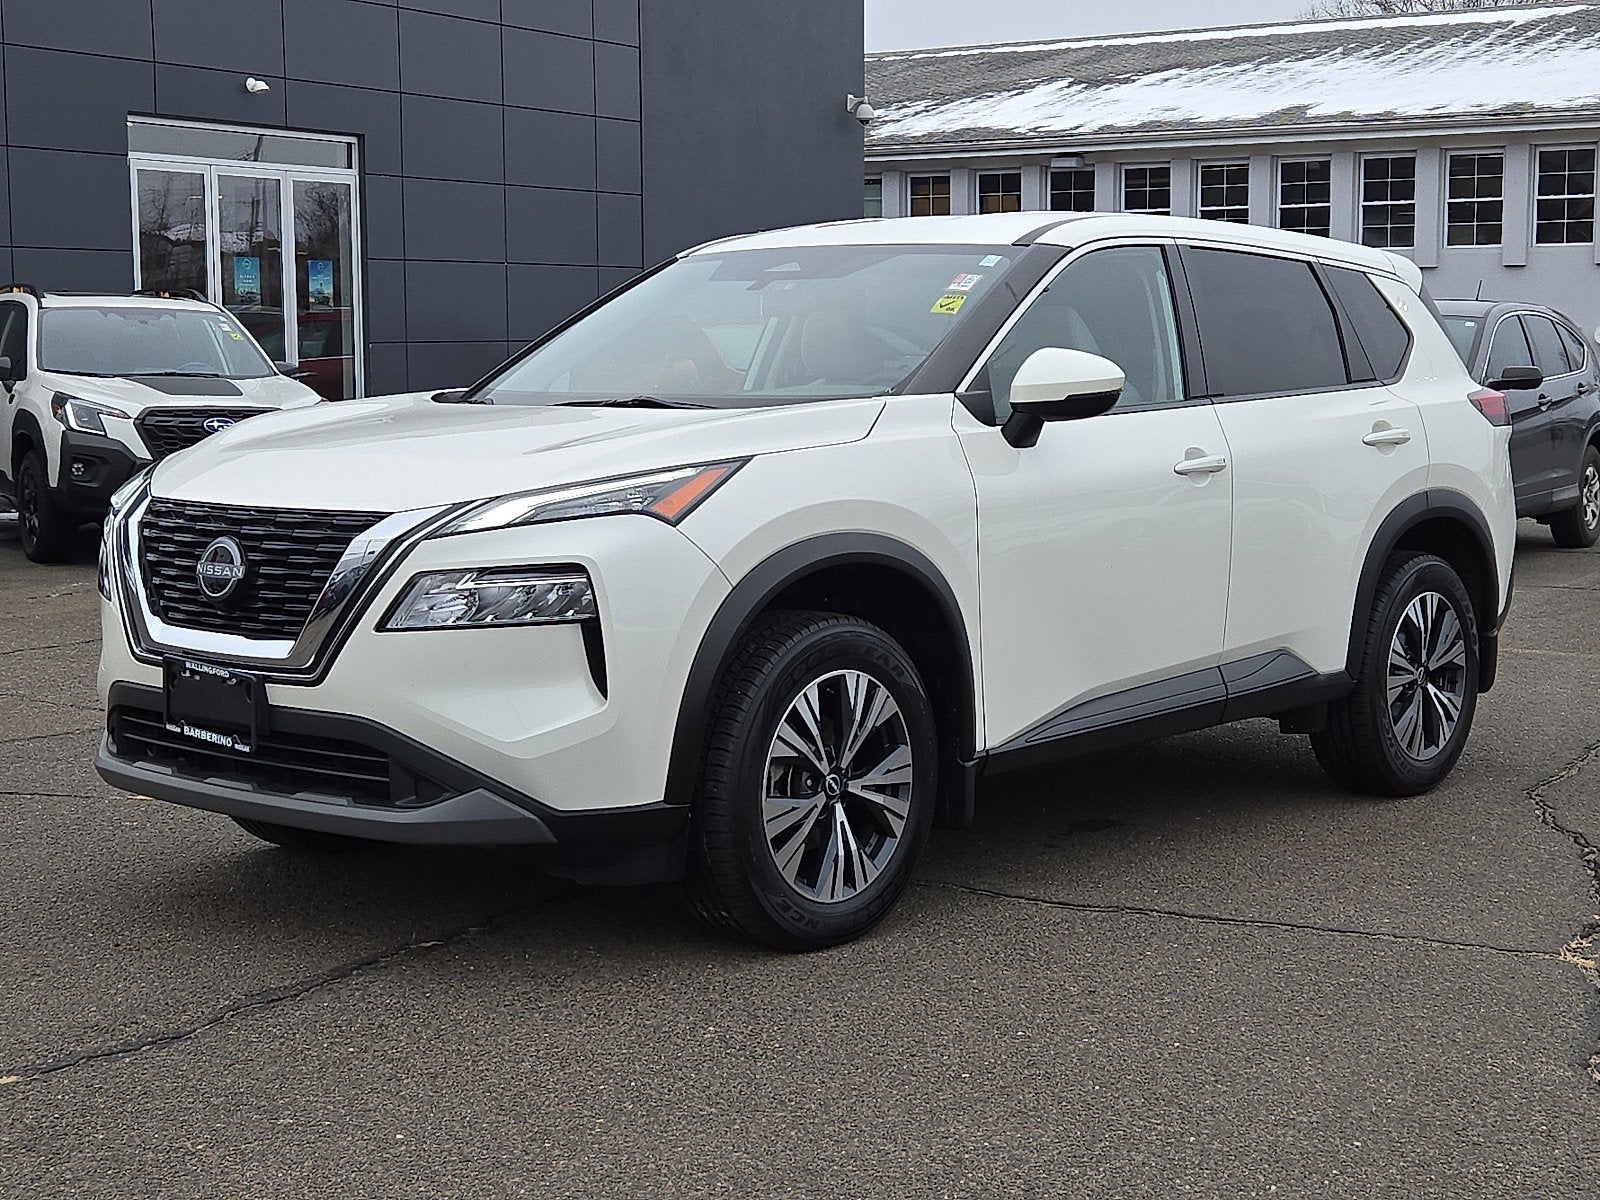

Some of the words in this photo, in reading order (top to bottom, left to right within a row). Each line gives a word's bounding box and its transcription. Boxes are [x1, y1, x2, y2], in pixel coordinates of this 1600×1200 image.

[197, 561, 243, 577] NISSAN
[185, 661, 230, 678] WALLINGFORD
[183, 725, 233, 747] BARBERINO
